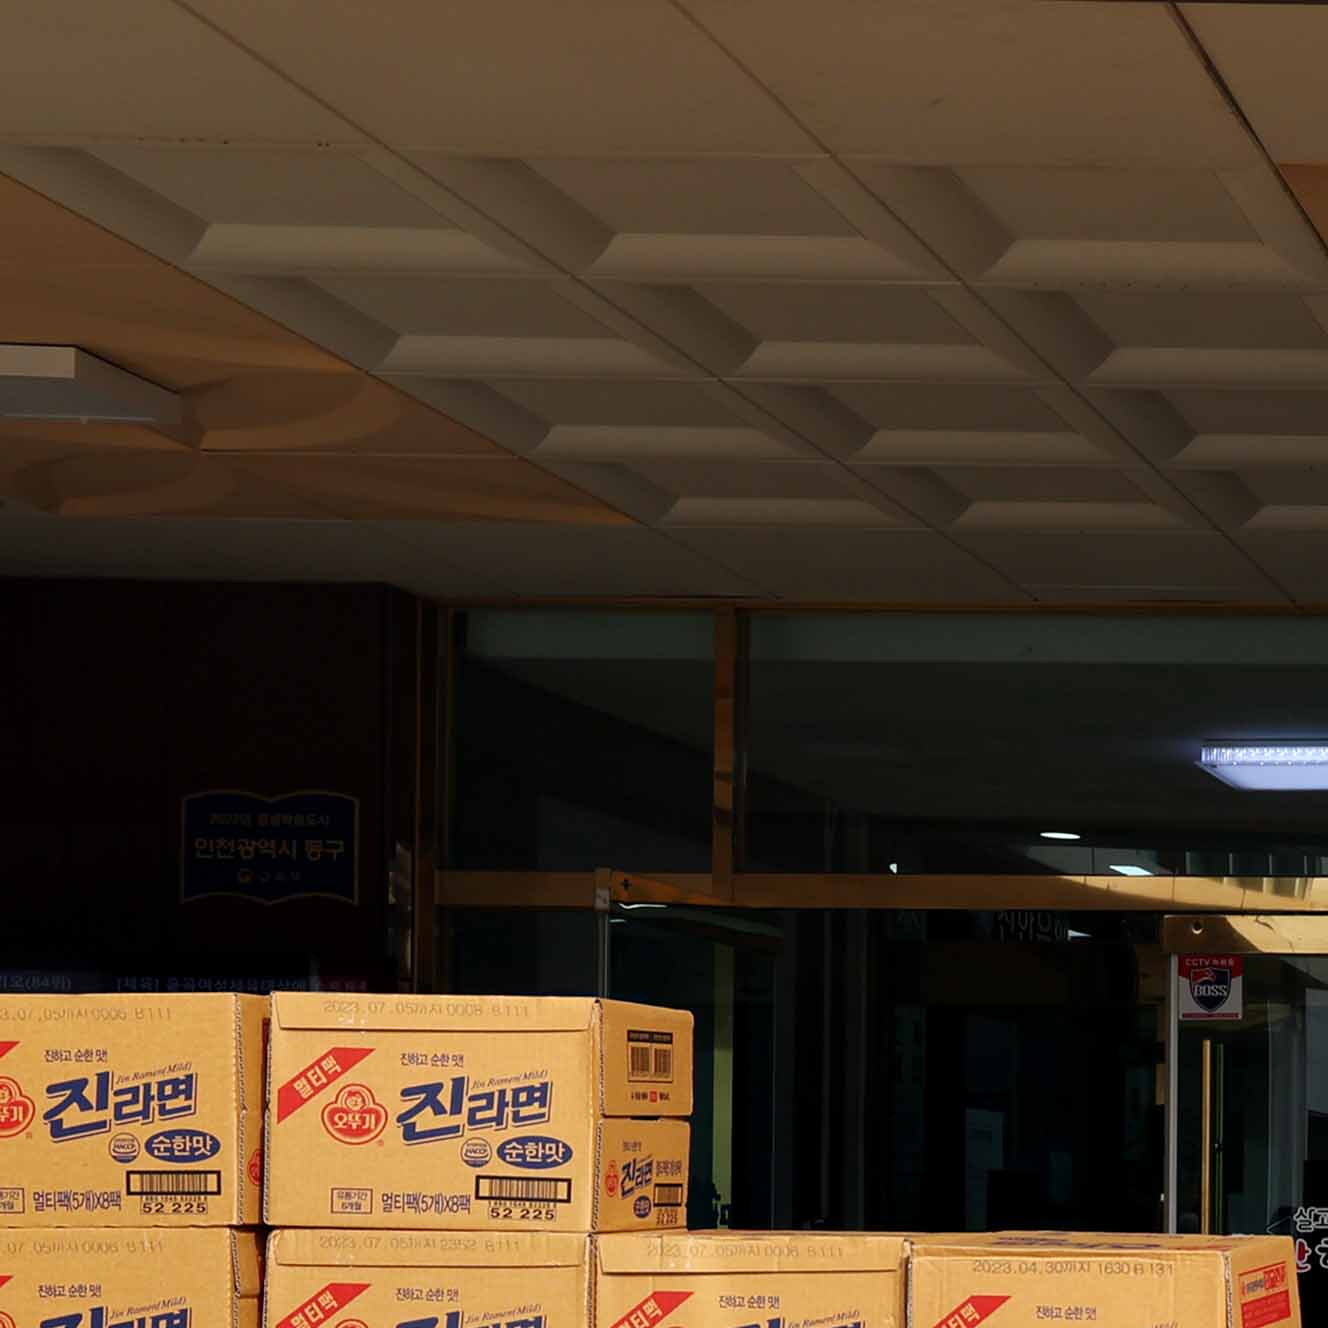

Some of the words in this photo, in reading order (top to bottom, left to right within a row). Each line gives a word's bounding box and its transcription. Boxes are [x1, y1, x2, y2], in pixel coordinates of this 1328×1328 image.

[1194, 984, 1229, 998] BOSS
[43, 1070, 198, 1143] 진라면
[396, 1075, 553, 1149] 진라면
